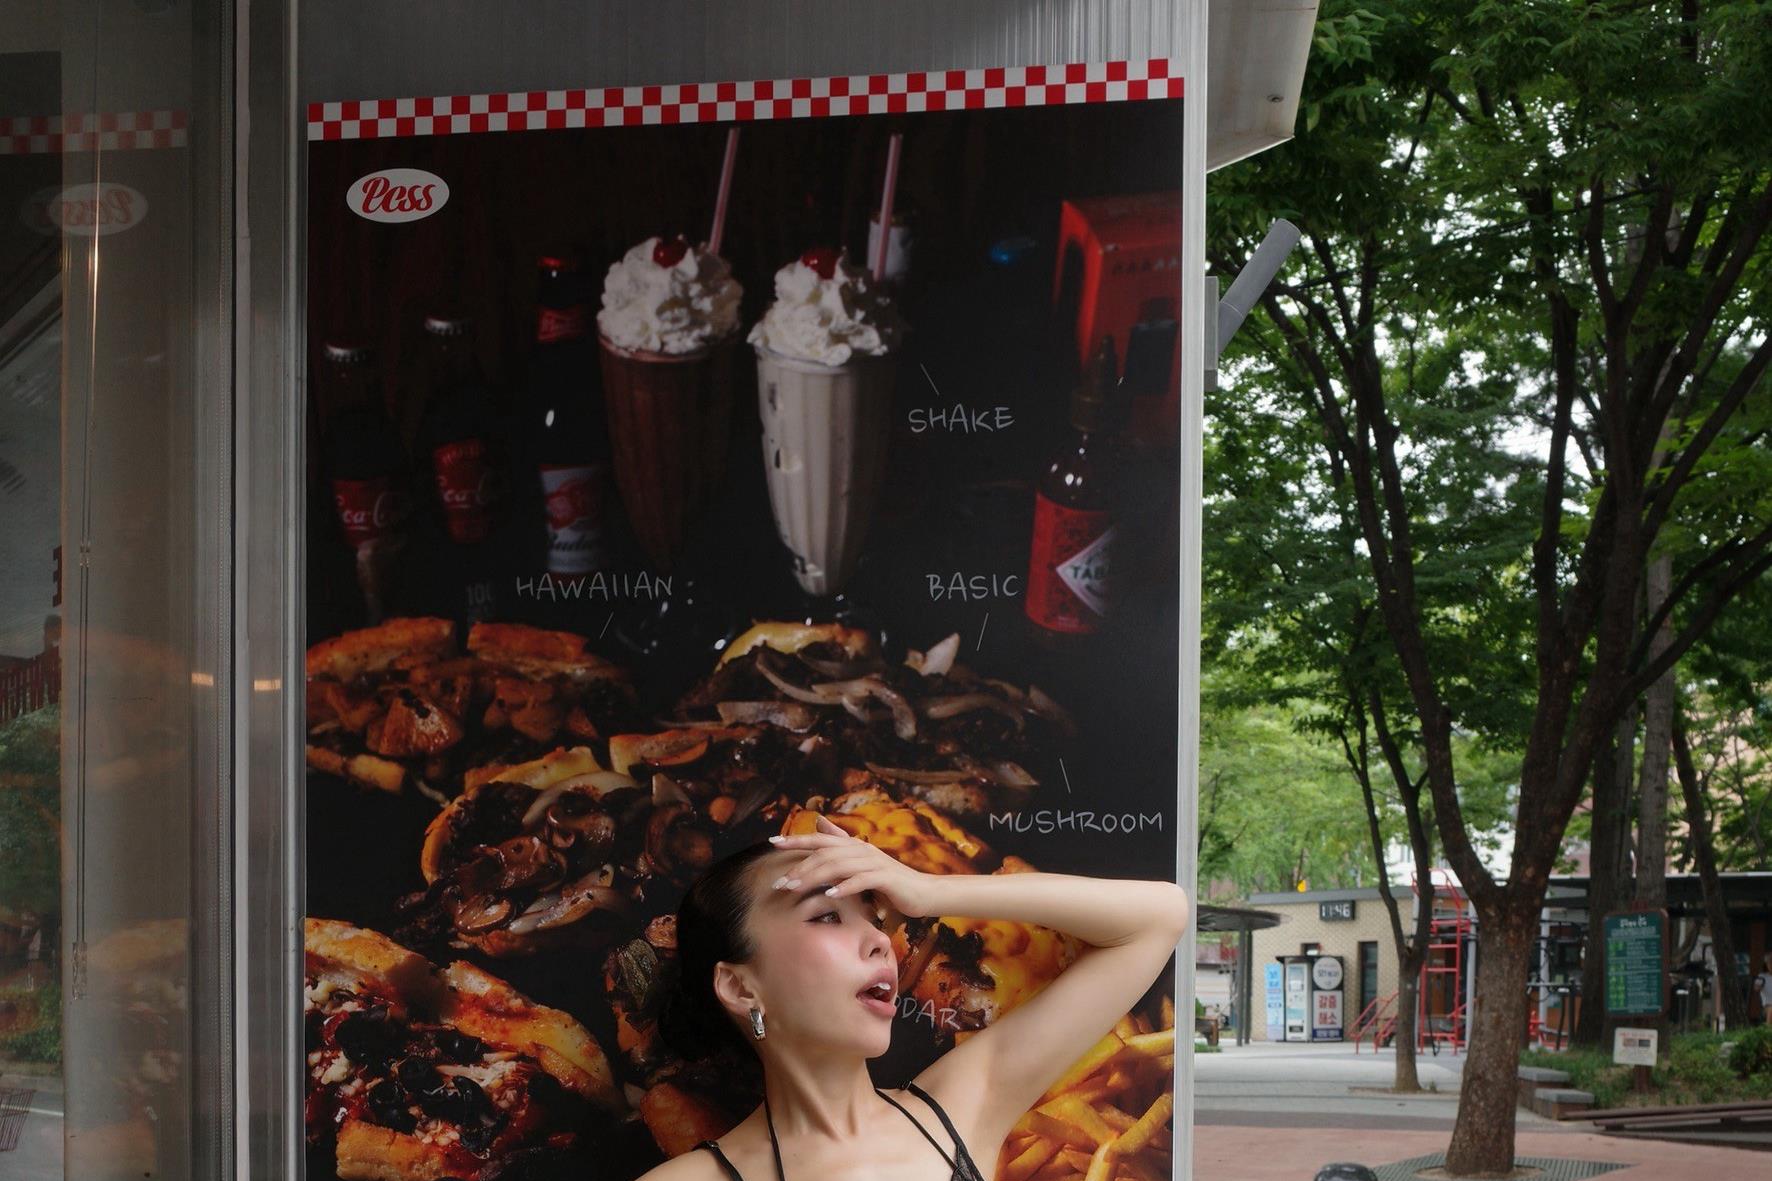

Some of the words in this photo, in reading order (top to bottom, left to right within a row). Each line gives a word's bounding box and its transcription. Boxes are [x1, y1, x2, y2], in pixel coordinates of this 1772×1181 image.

[361, 176, 437, 214] Pess
[907, 403, 1016, 433] SHAKE
[515, 571, 674, 602] HAWAIIAN
[926, 571, 1022, 601] BASIC
[988, 809, 1163, 834] MUSHROOM
